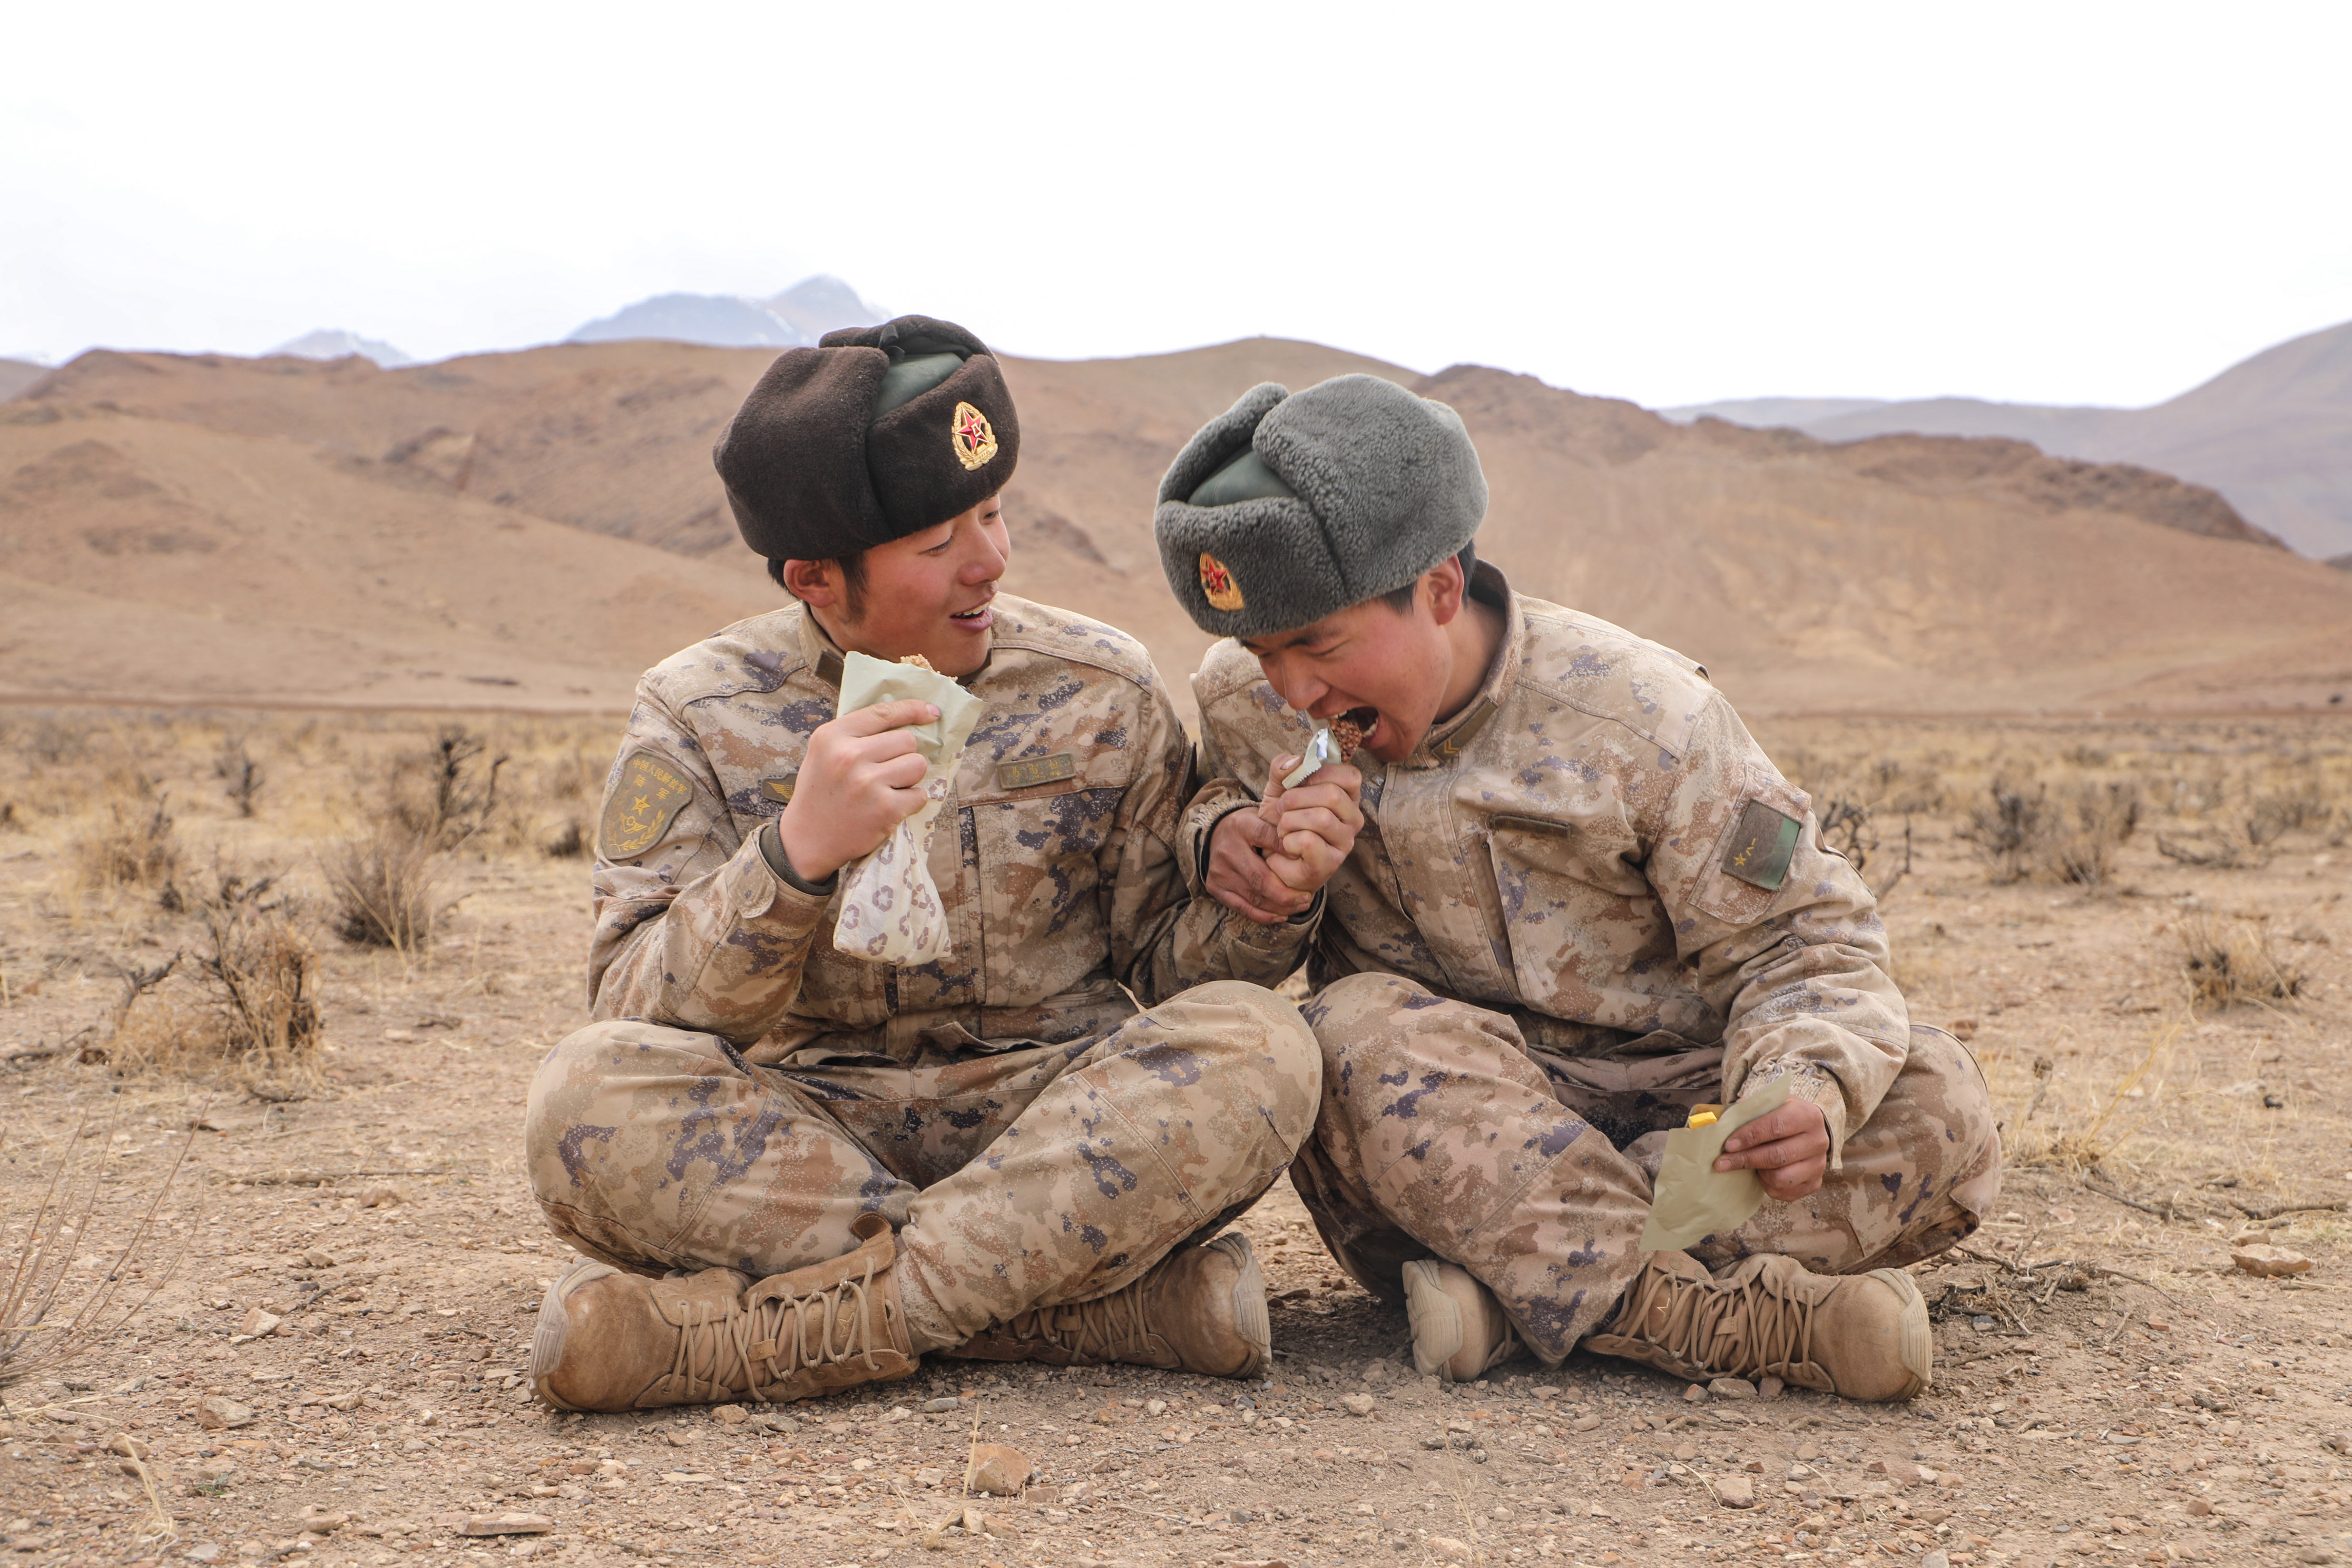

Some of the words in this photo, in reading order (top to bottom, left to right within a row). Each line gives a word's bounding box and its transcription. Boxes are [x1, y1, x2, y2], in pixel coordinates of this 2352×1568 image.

[633, 758, 688, 794] 中国人民解放军
[633, 774, 670, 800] 陆军
